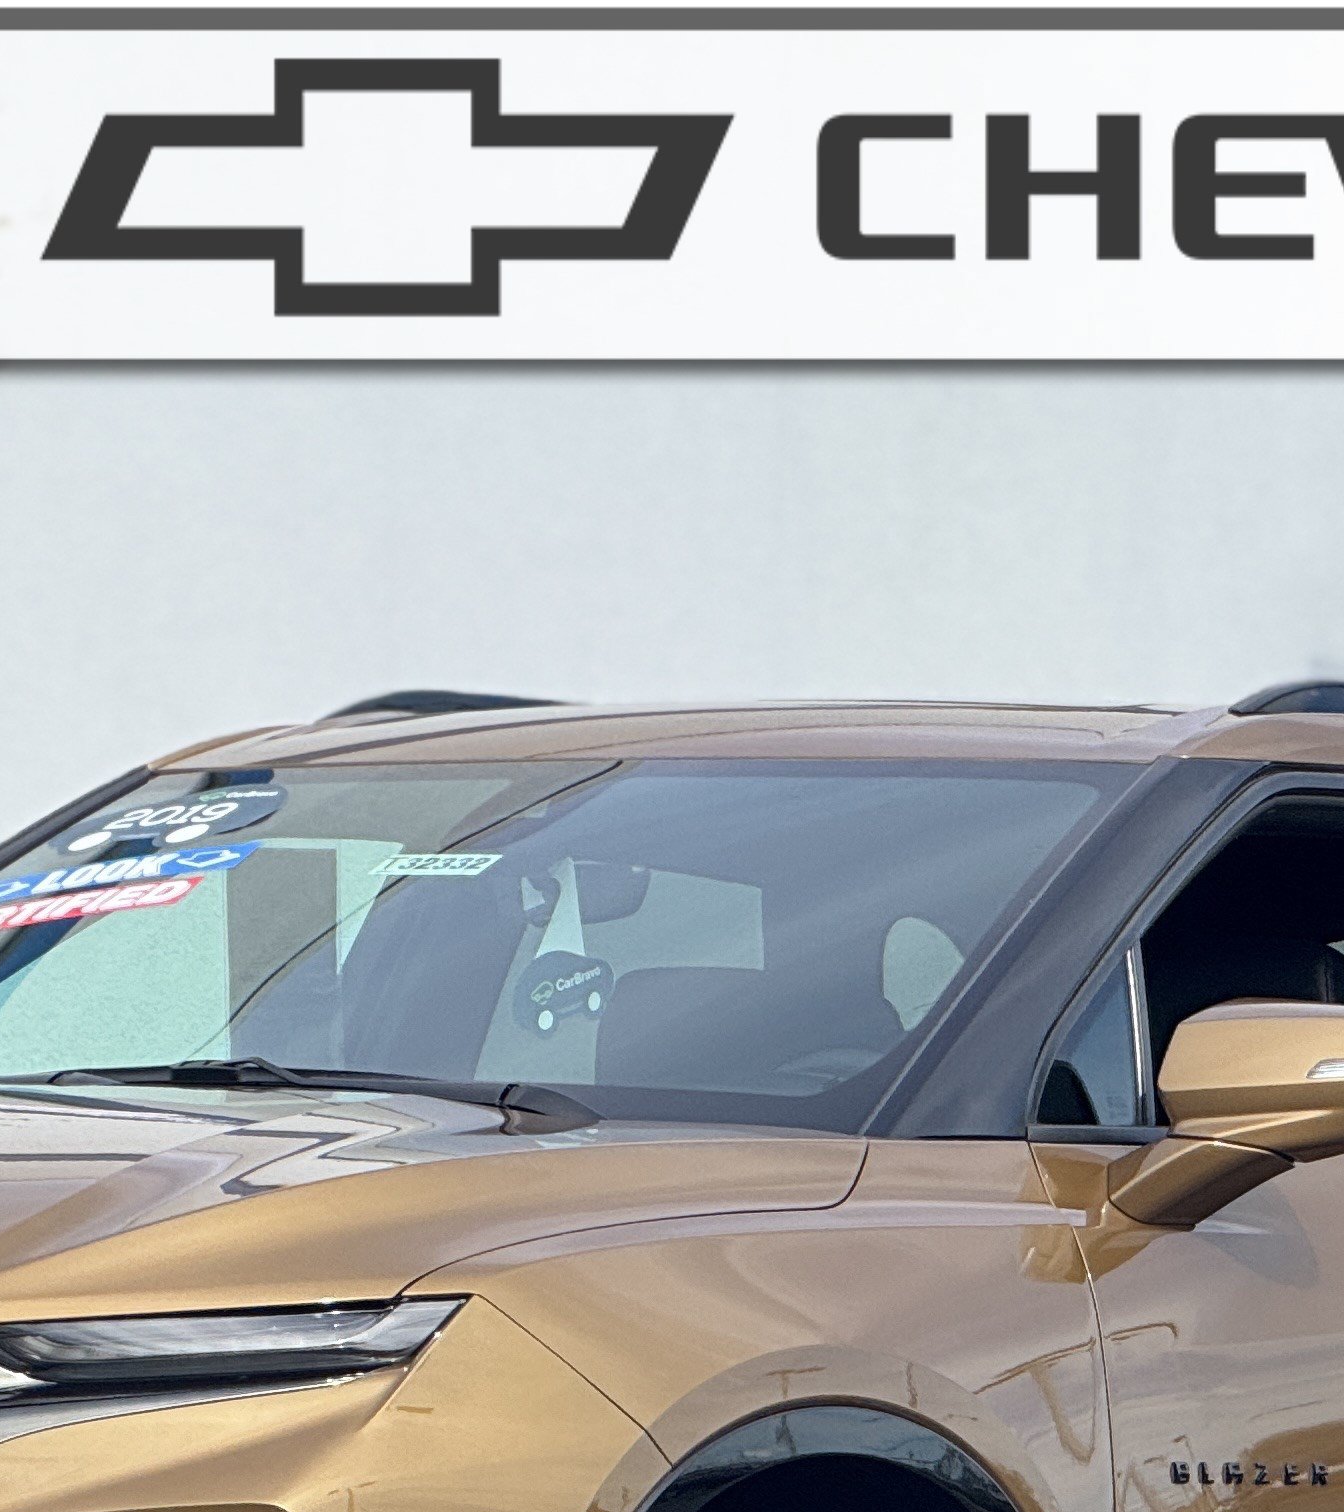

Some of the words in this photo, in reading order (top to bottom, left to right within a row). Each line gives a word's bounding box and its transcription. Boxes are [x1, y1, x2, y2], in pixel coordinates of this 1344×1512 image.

[103, 802, 239, 830] 2019
[31, 853, 179, 894] LOOK
[1170, 1461, 1329, 1486] BLAZER
